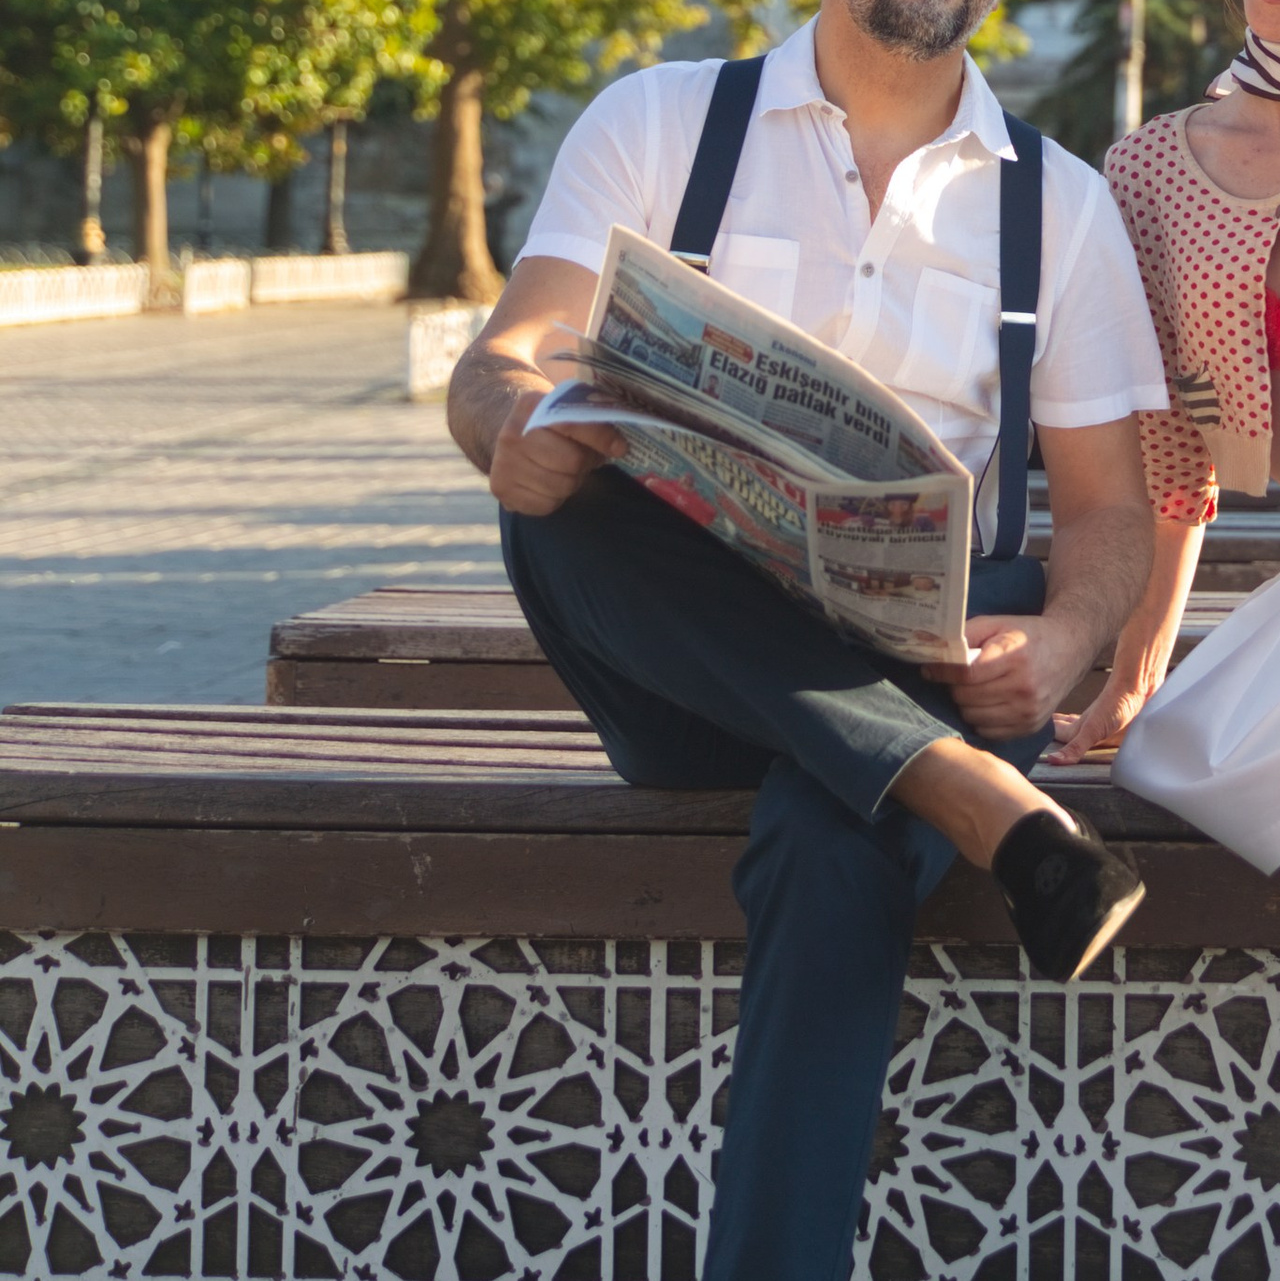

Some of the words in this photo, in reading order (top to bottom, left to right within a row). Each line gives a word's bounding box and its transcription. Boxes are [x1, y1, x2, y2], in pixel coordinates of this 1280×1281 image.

[755, 351, 850, 407] Eskişehir
[855, 399, 892, 434] bitti
[771, 339, 817, 368] Ekonomi
[709, 349, 768, 396] Elazığ
[772, 383, 837, 420] patlak
[843, 410, 890, 450] verdi
